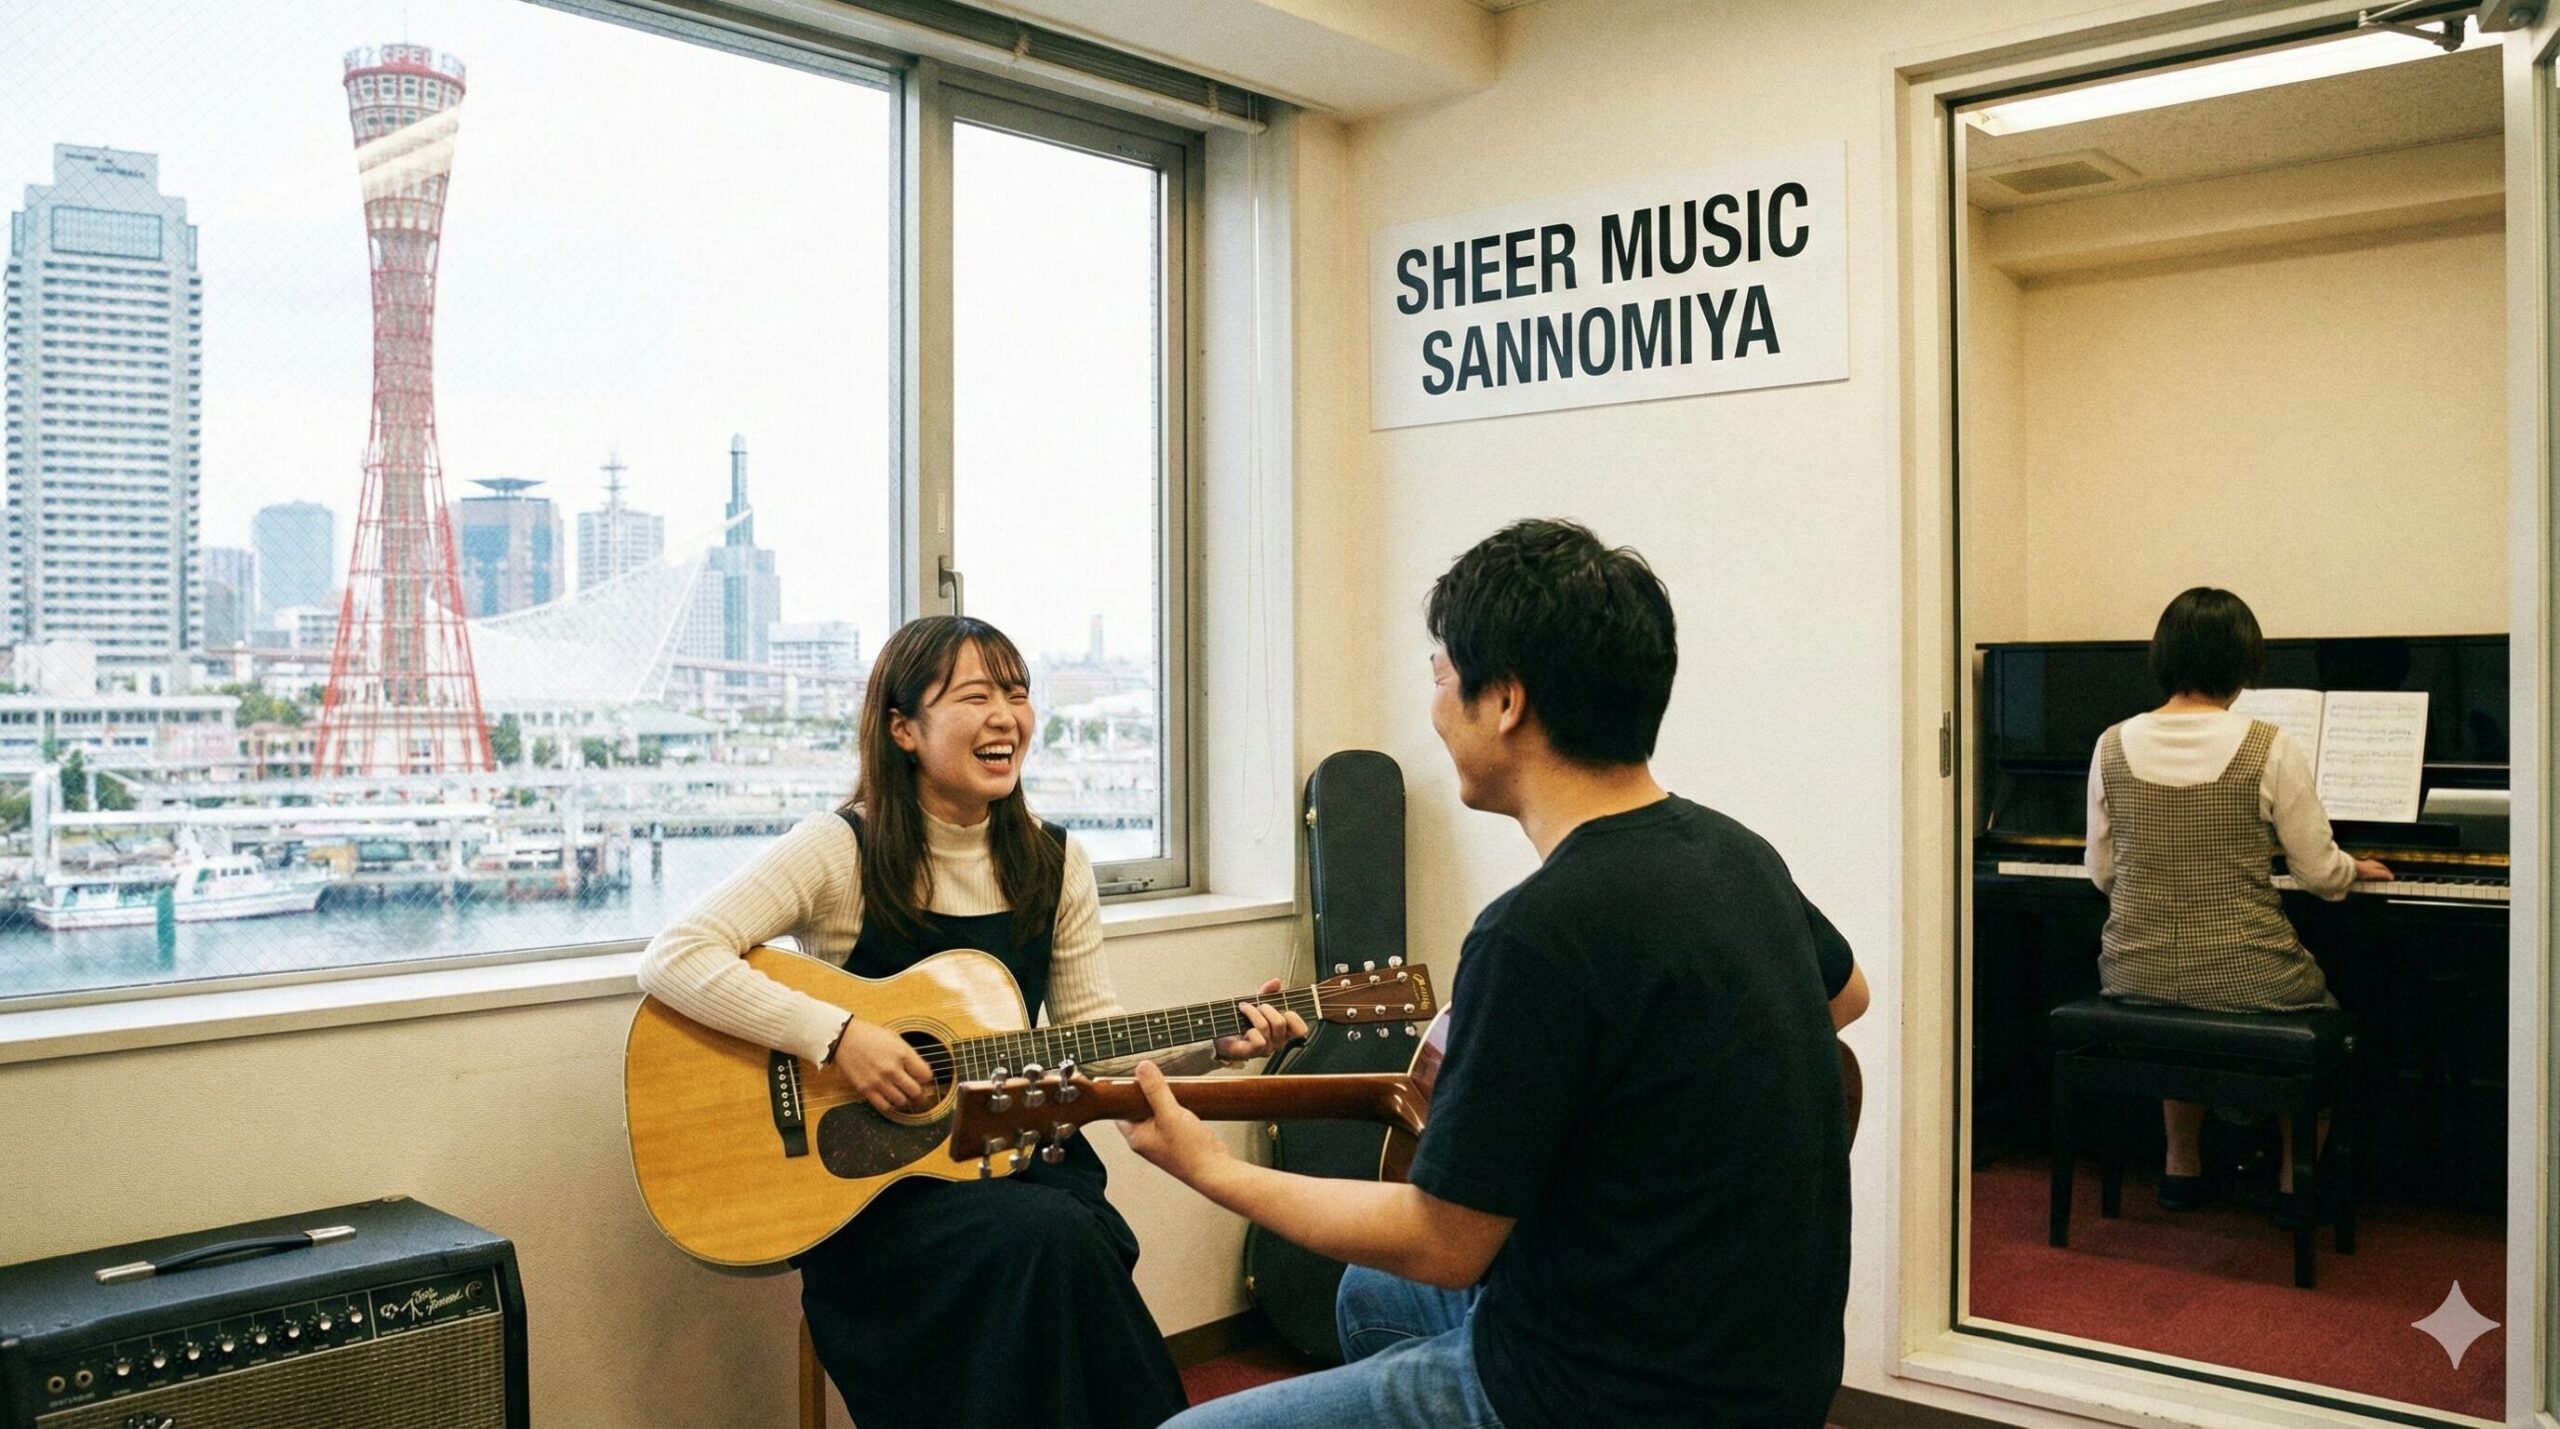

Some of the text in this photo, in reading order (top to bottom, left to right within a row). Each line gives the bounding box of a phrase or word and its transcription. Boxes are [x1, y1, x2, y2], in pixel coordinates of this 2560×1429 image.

[1396, 182, 1810, 315] SHEER MUSIC
[1422, 284, 1781, 396] SANNOMIYA
